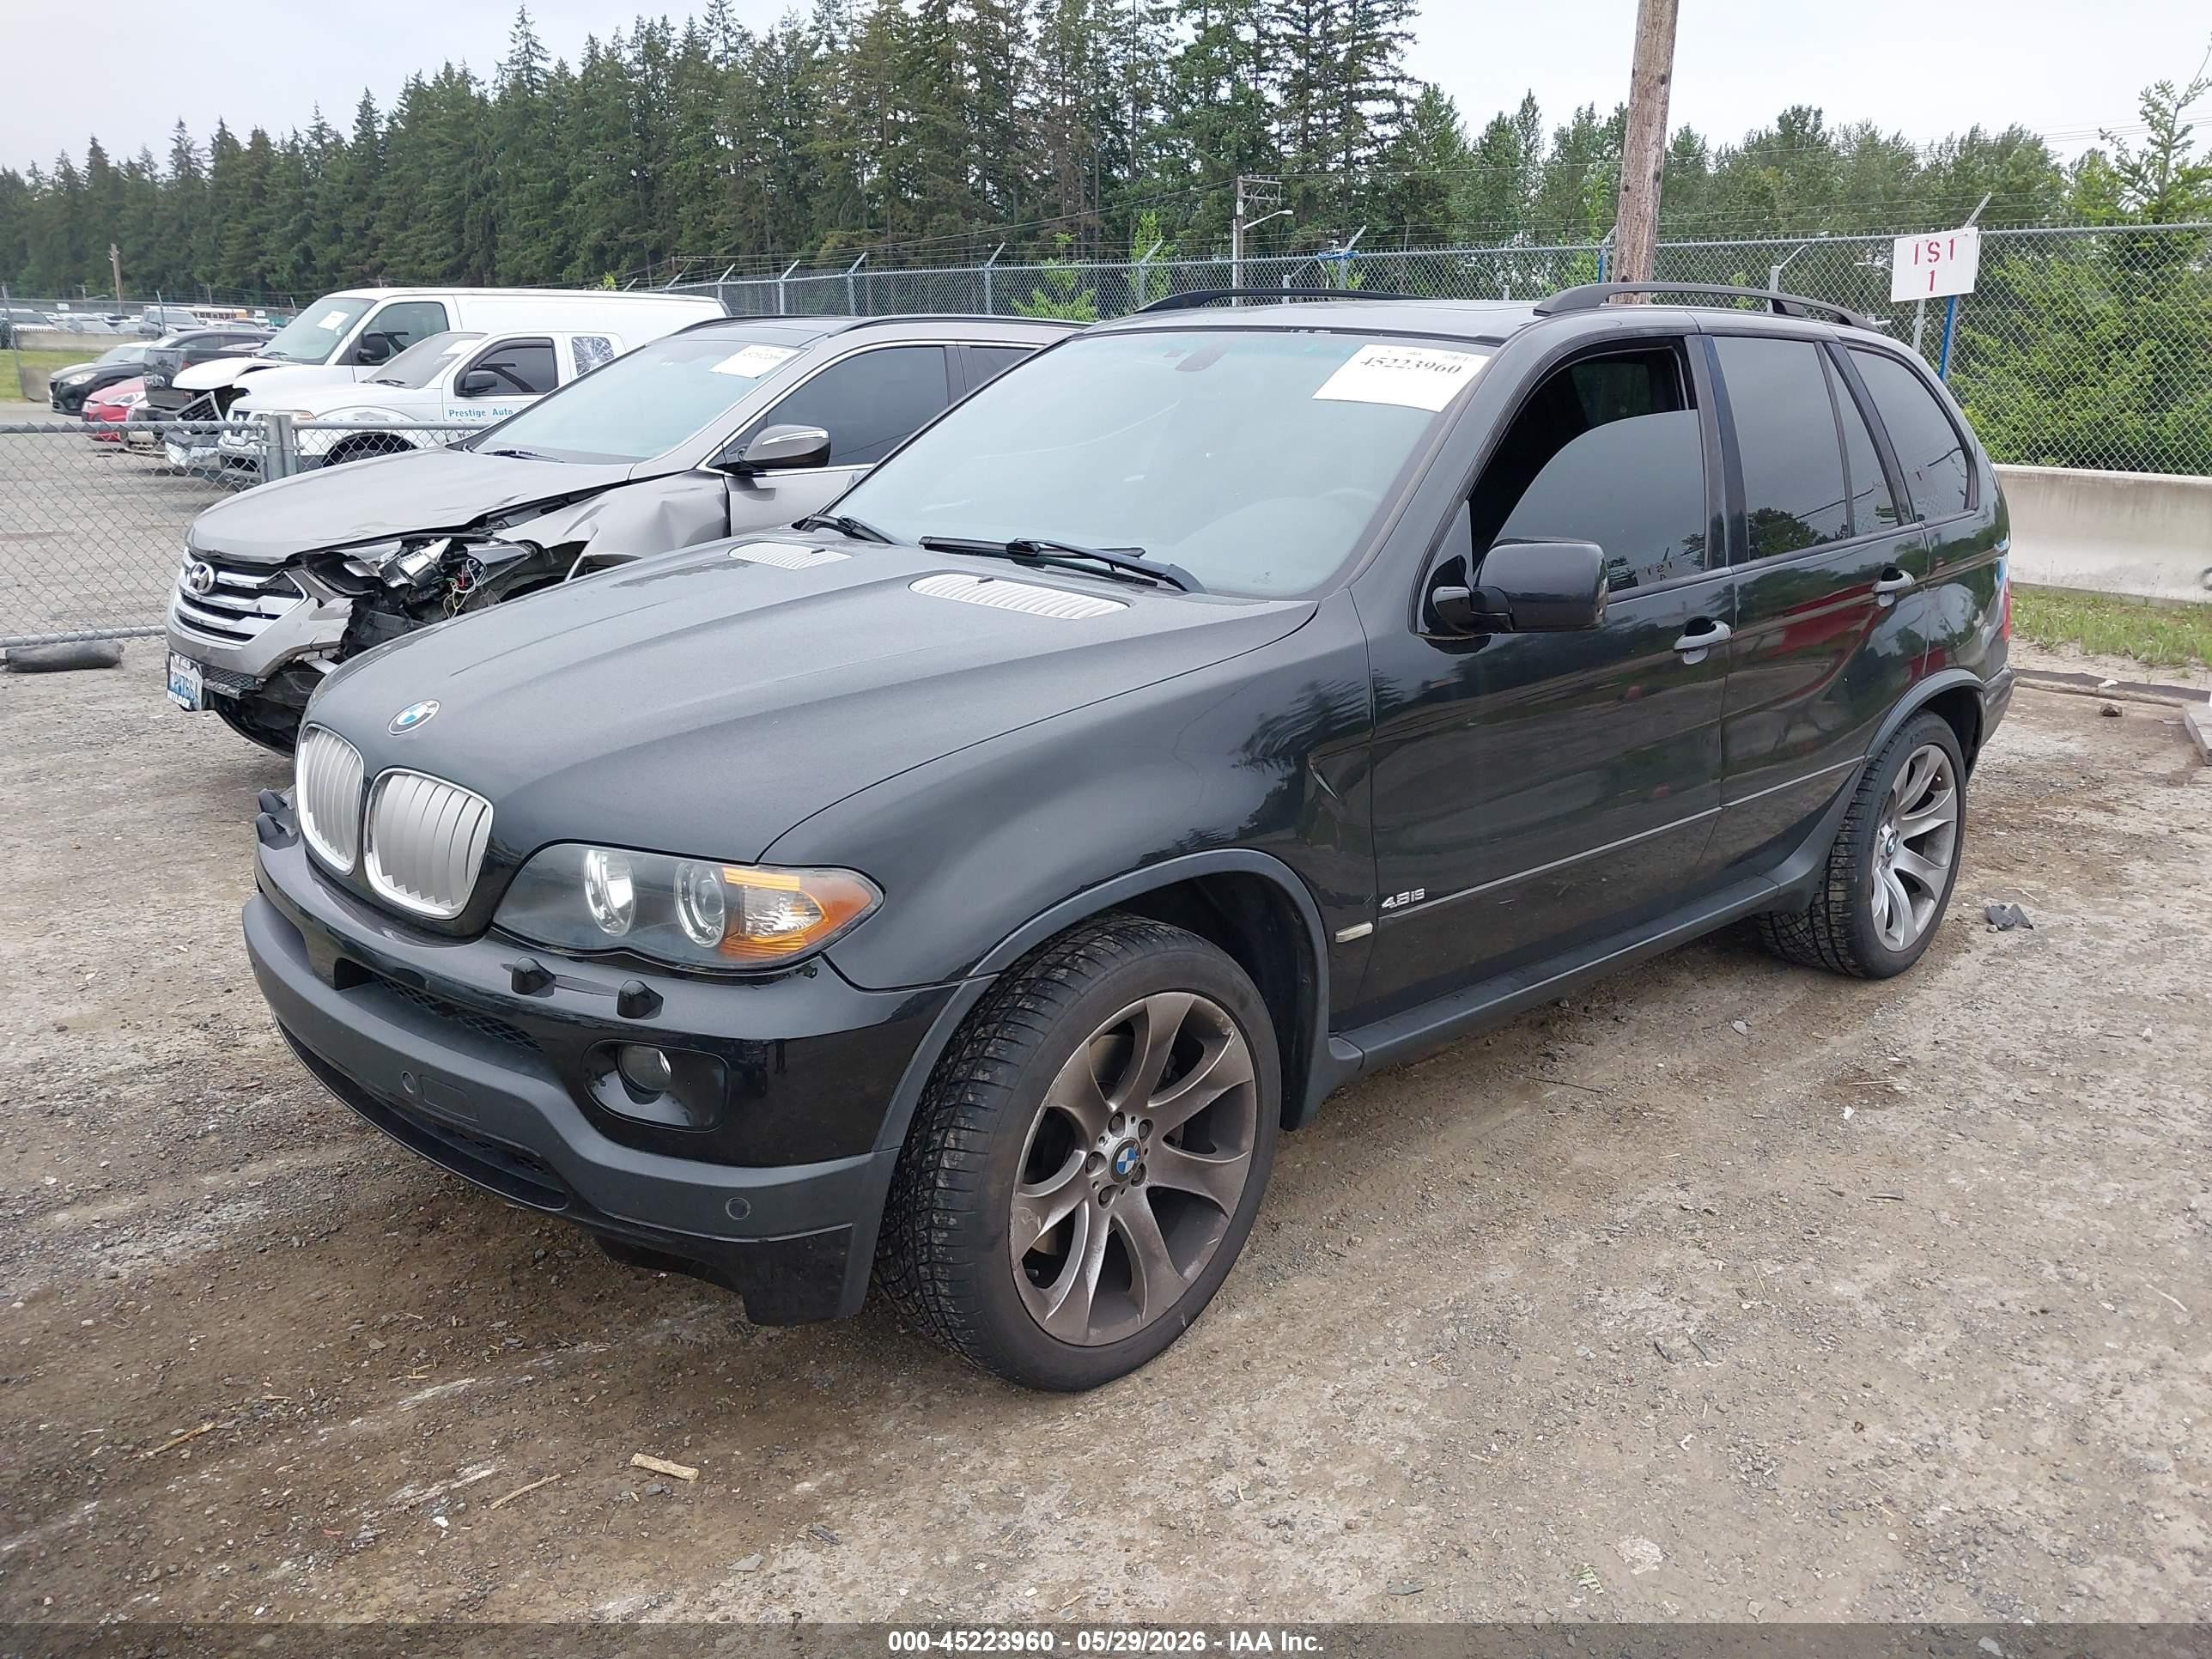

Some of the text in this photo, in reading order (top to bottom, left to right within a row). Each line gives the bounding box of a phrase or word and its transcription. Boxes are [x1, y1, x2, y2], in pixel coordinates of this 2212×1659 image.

[1929, 270, 1935, 291] 1
[1360, 356, 1462, 374] 45223960
[448, 407, 514, 417] Prestige Auto
